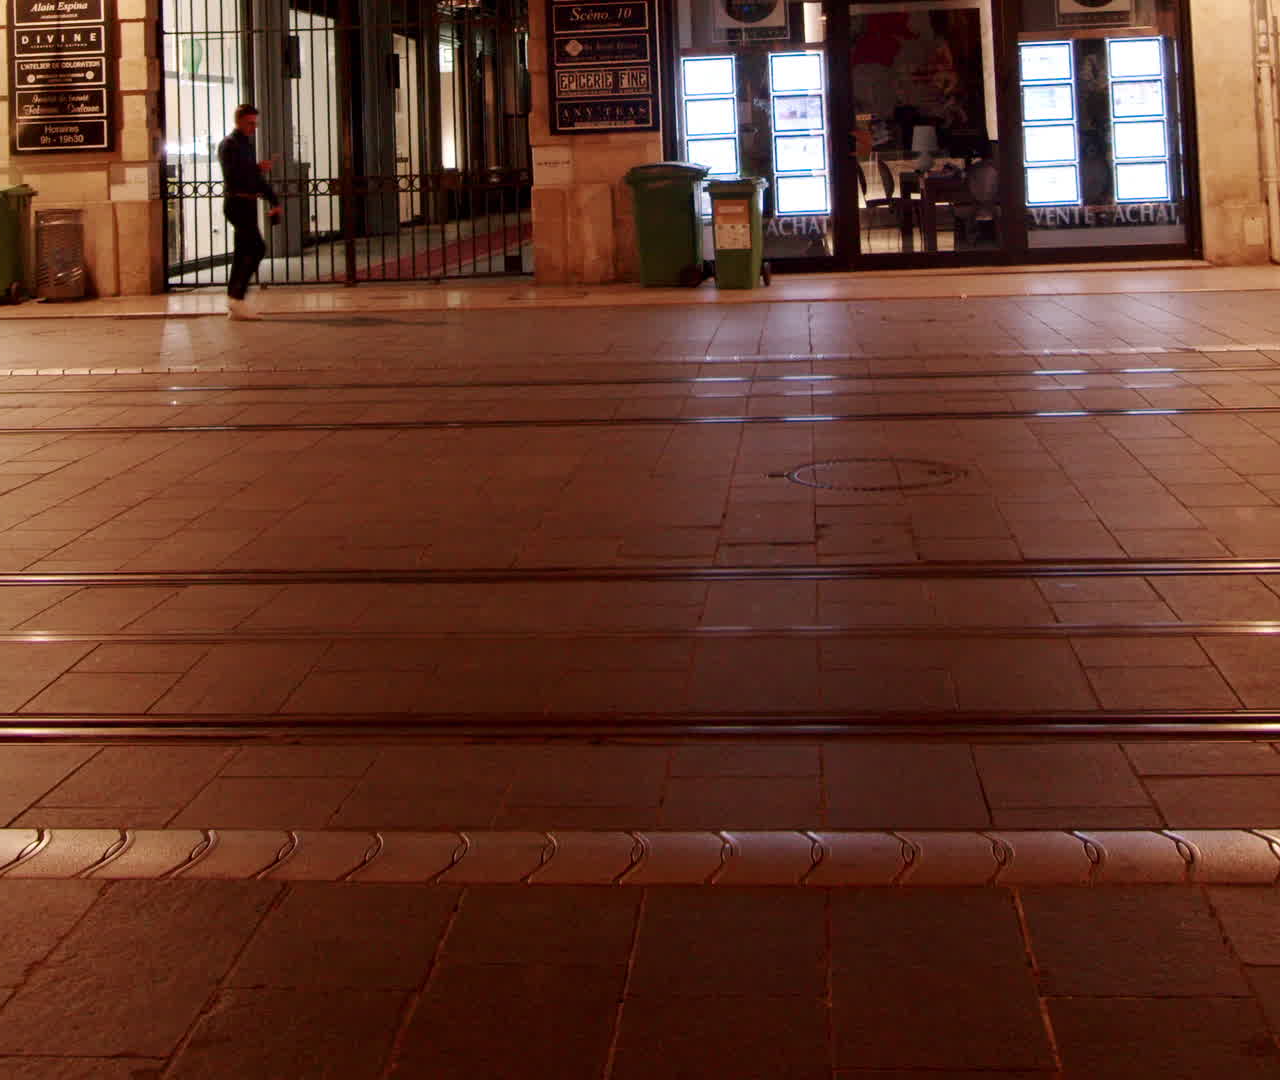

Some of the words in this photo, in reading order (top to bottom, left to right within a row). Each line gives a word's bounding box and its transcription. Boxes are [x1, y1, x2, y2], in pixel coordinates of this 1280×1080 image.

[30, 2, 55, 13] Alain
[57, 1, 88, 13] Espina
[21, 32, 97, 45] DIVINE
[560, 72, 612, 89] EPICERIE
[620, 71, 646, 88] FINE
[44, 125, 80, 134] Horaires
[40, 136, 51, 145] 9h
[60, 135, 84, 144] 19h30
[1031, 206, 1091, 226] VENTE
[1112, 202, 1179, 224] ACHAT
[767, 216, 830, 237] ACHAT
